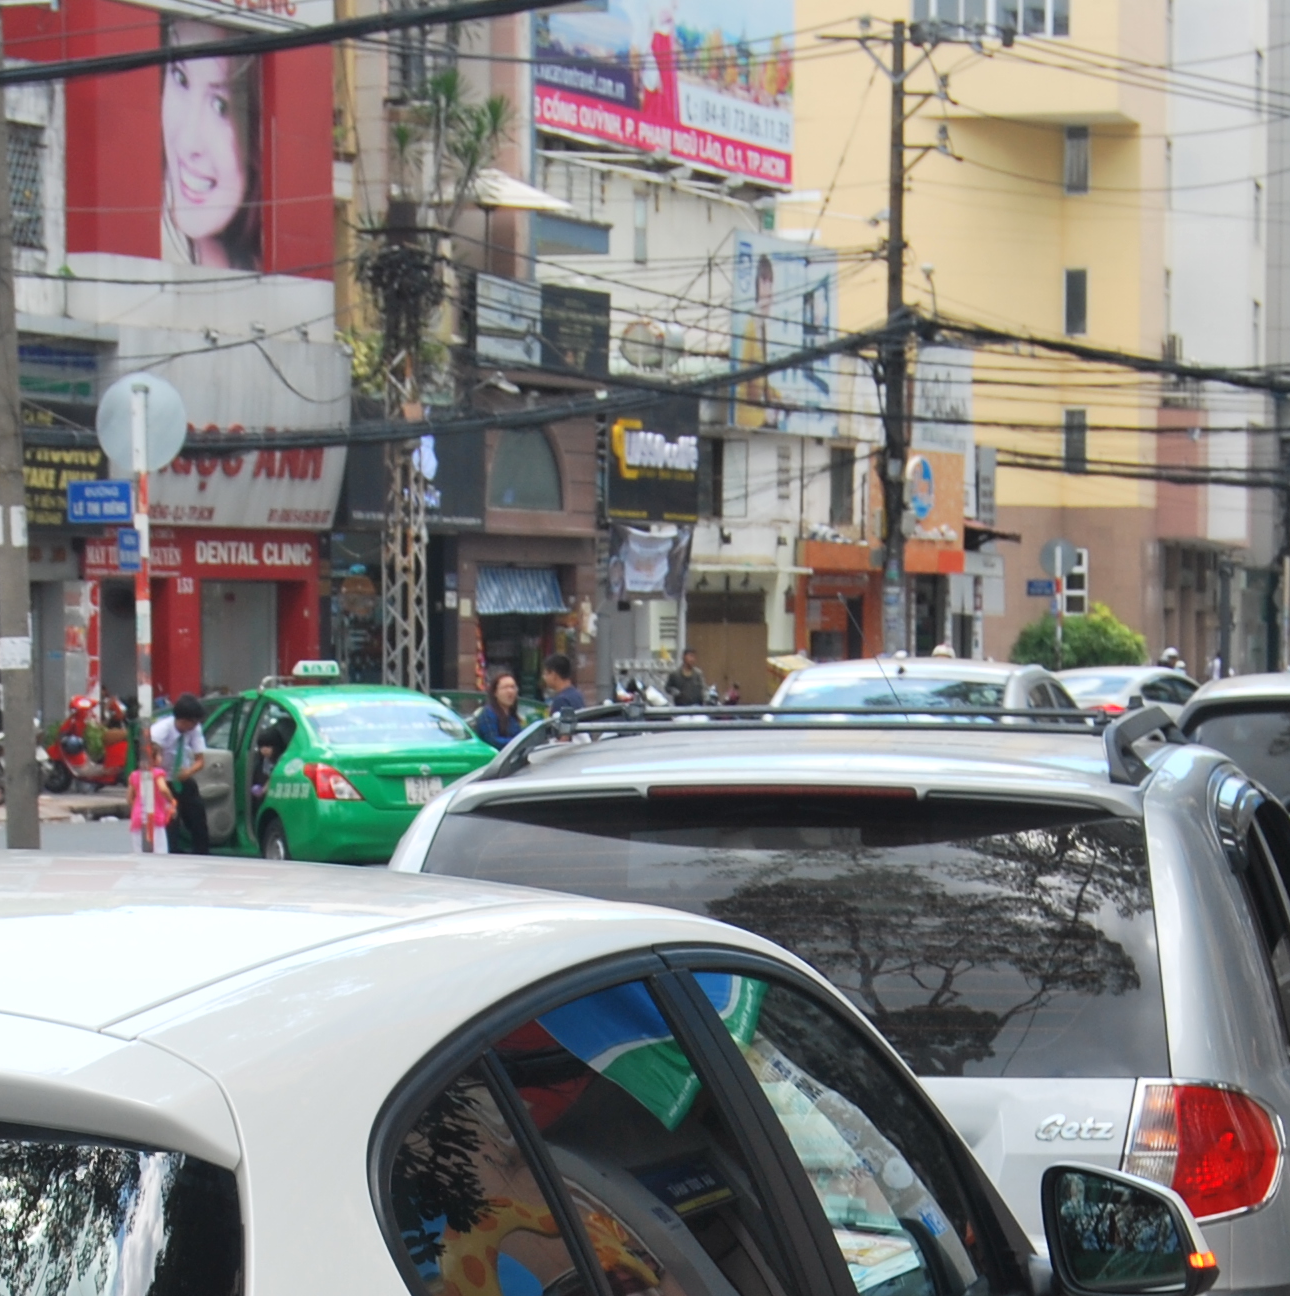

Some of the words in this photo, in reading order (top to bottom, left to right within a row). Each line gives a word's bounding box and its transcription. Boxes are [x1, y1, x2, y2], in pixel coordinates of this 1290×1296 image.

[195, 541, 260, 565] DENTAL
[262, 542, 312, 566] CLINIC
[1035, 1113, 1114, 1142] Getz
